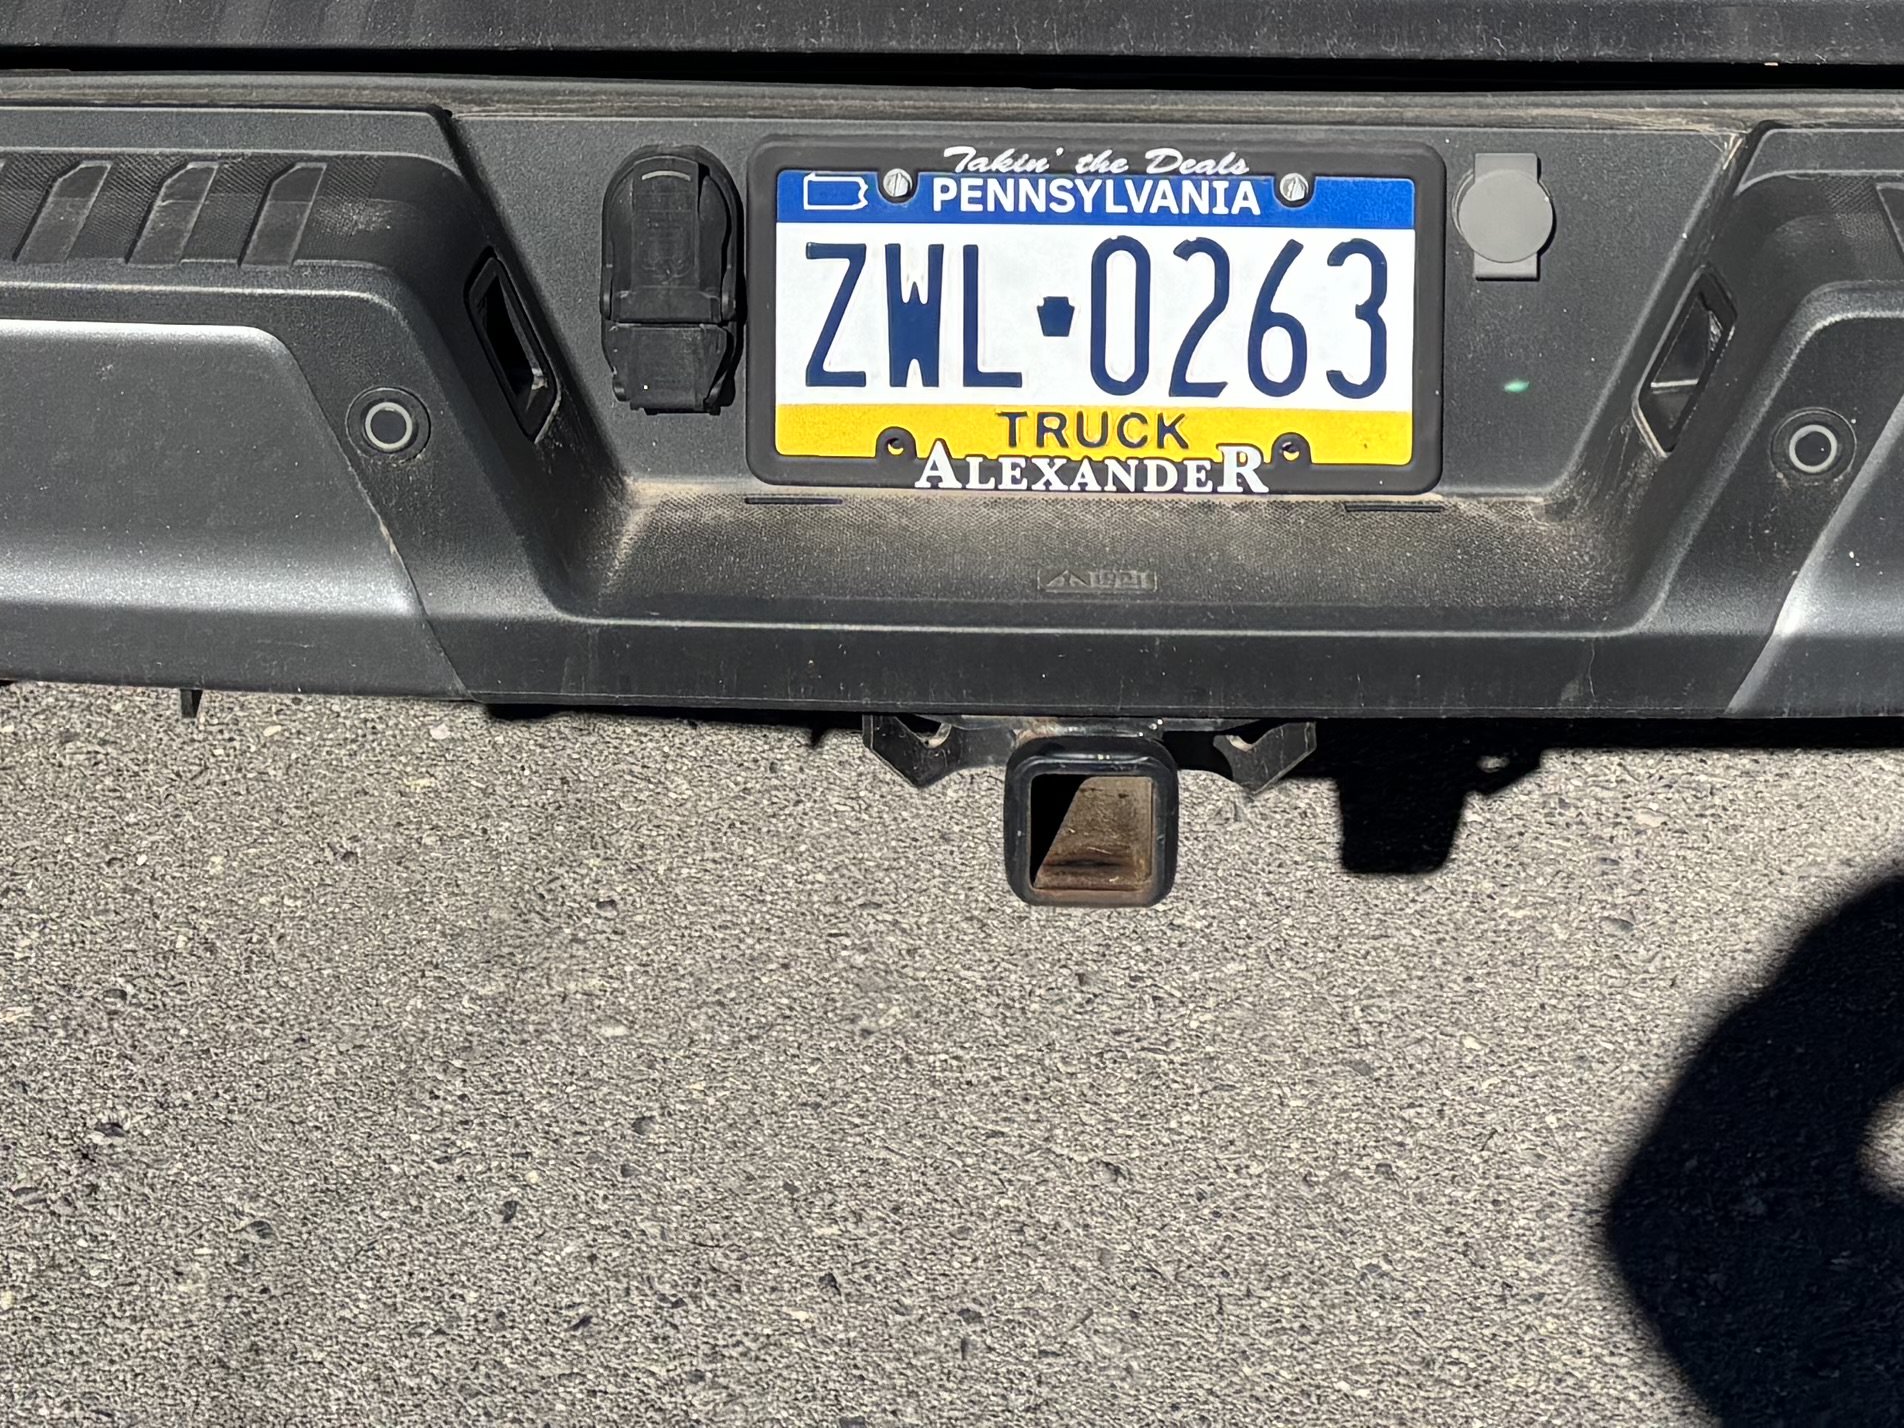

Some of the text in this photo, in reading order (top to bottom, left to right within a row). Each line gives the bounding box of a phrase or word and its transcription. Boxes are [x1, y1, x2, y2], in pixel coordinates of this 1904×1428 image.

[943, 146, 1250, 176] Takin' the Deals
[932, 177, 1262, 216] PENNSYLVANIA
[805, 235, 1388, 400] ZWL 0263
[996, 410, 1190, 450] TRUCK
[914, 438, 1270, 494] ALEXANDER
